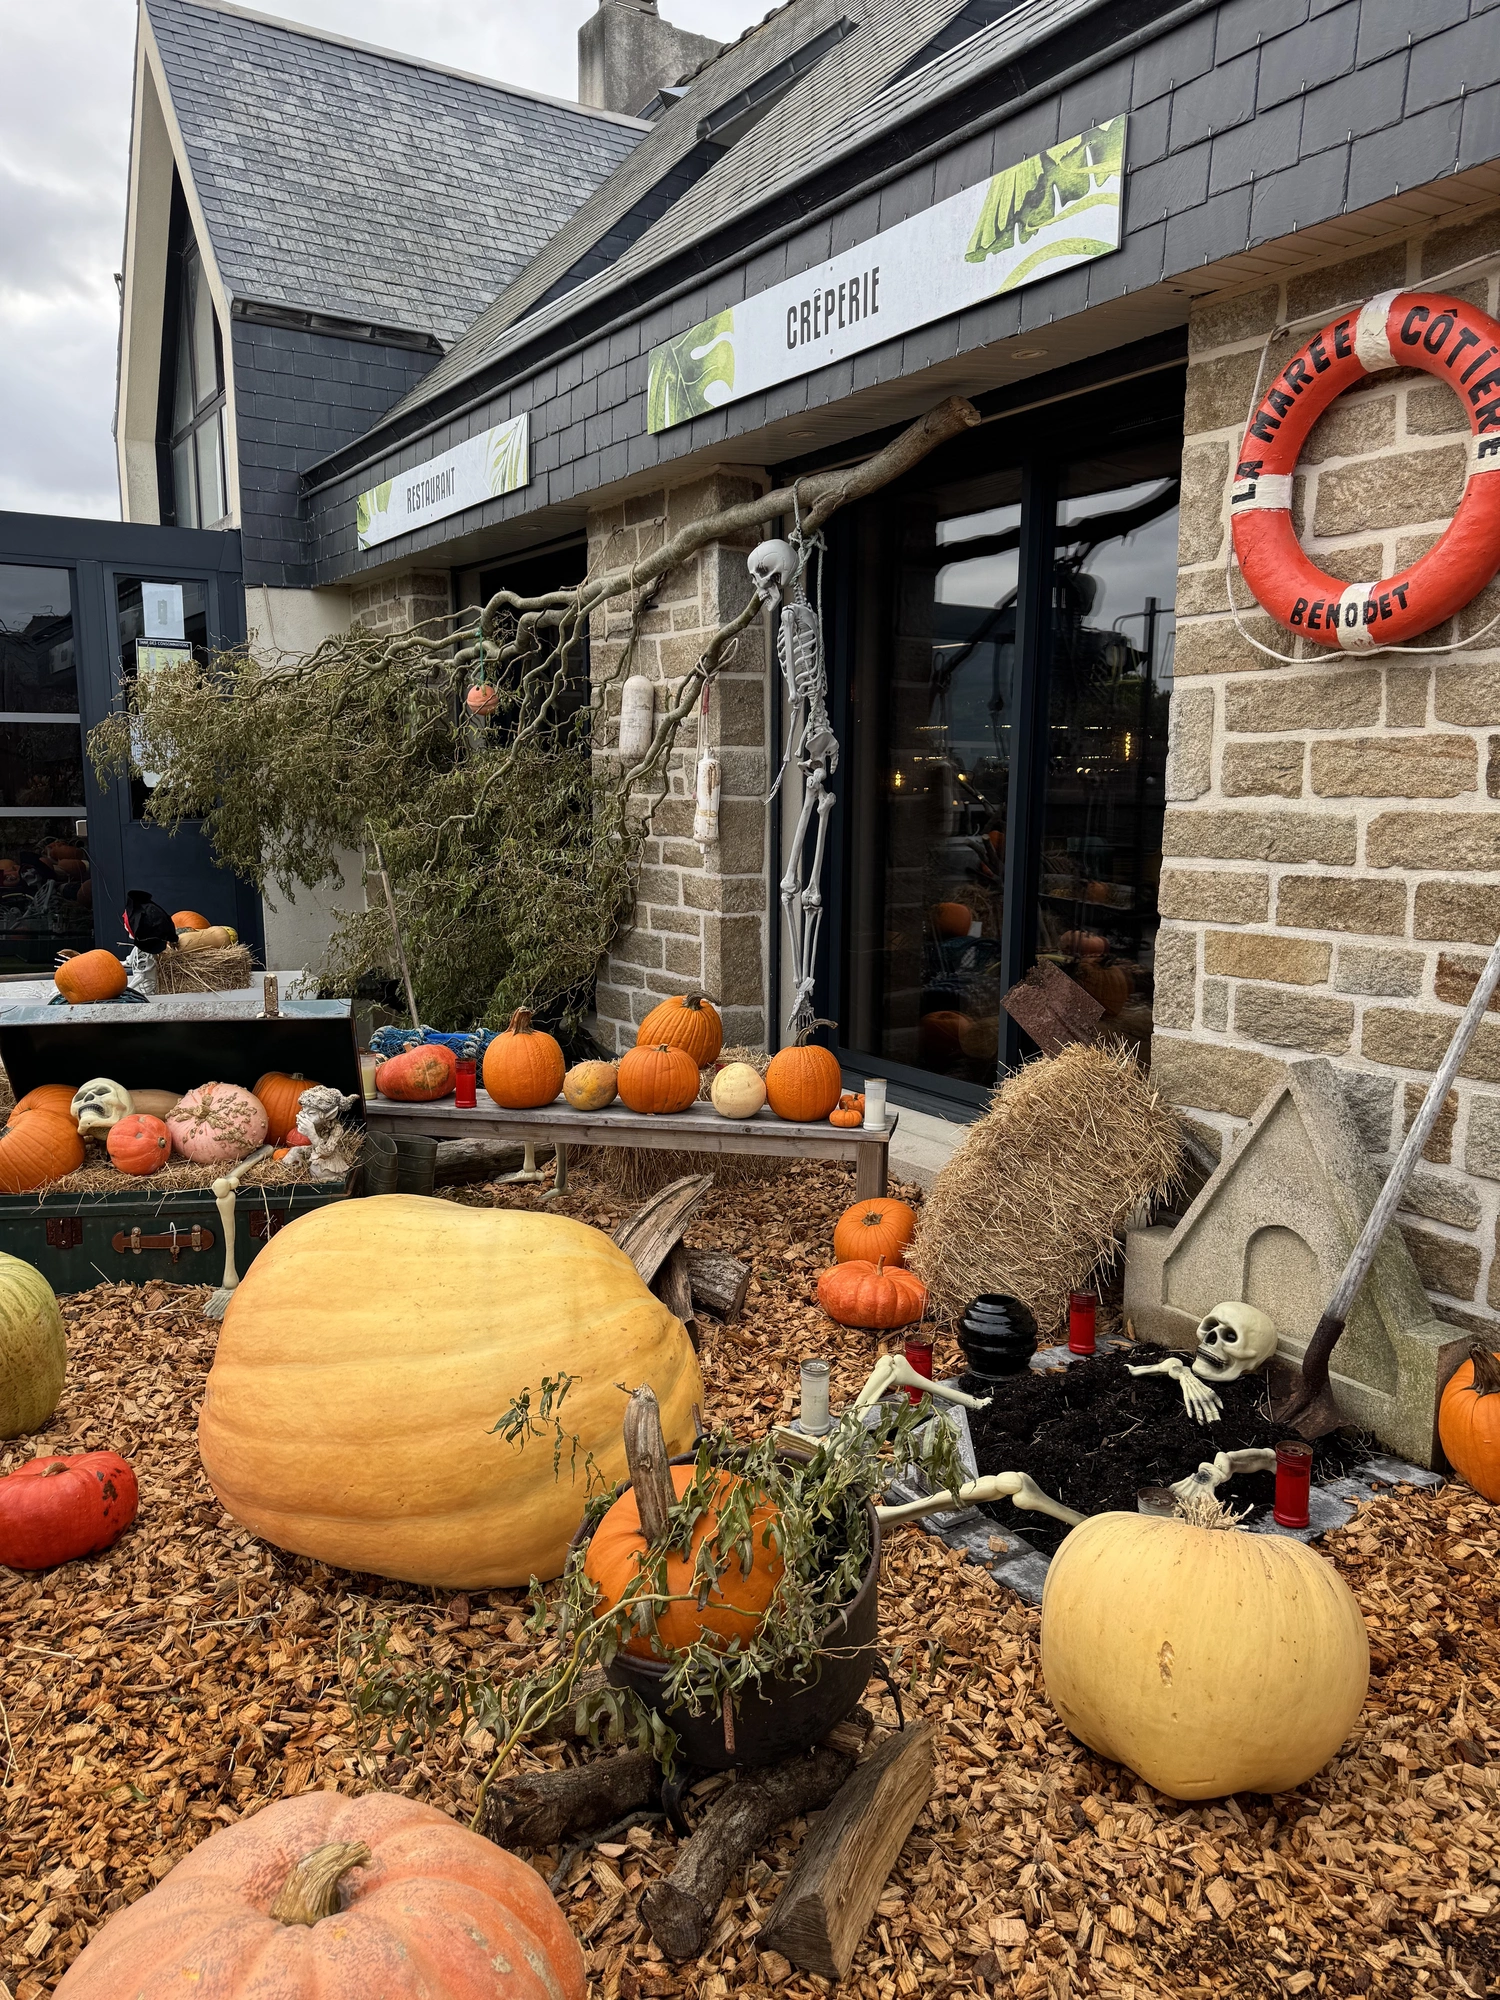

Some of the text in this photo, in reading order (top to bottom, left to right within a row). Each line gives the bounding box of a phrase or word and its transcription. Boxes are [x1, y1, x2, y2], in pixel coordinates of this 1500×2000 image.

[787, 265, 880, 350] CRÊPERIE
[1231, 460, 1264, 505] LA
[1250, 319, 1353, 444] MARÉE
[406, 466, 456, 515] RESTAURANT
[1289, 581, 1410, 630] BÉNODET
